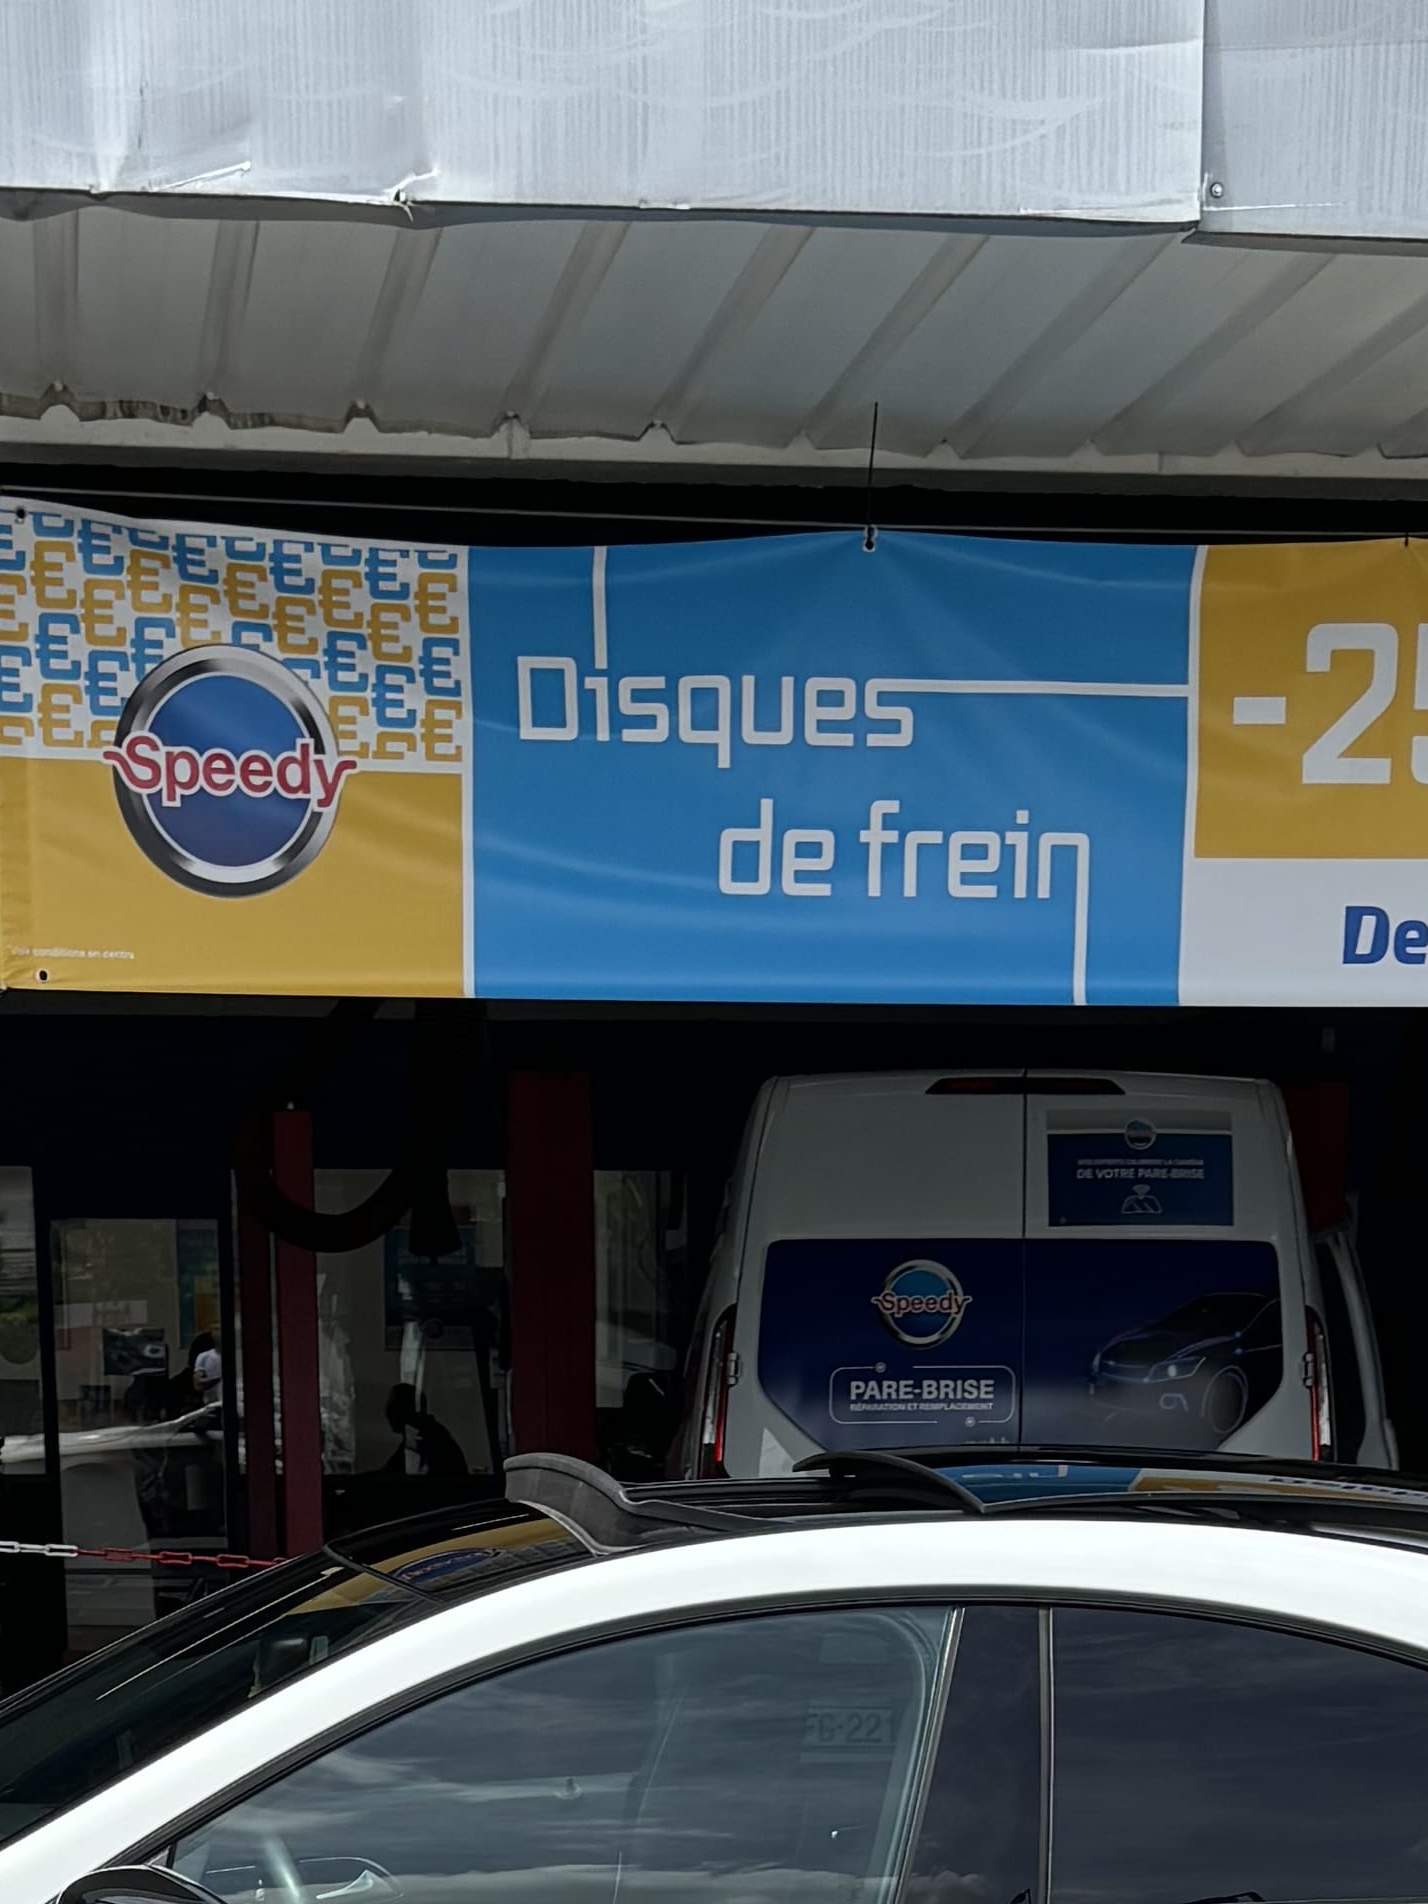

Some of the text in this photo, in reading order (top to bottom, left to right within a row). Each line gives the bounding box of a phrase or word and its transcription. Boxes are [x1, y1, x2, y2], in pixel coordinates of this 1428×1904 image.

[518, 656, 914, 768] Disques
[103, 734, 358, 809] Speedy
[718, 798, 1091, 900] de frein
[1076, 1167, 1205, 1180] DE VOTRE PARE-BRISE
[871, 1290, 973, 1318] Speedy
[849, 1379, 995, 1400] PARE-BRISE
